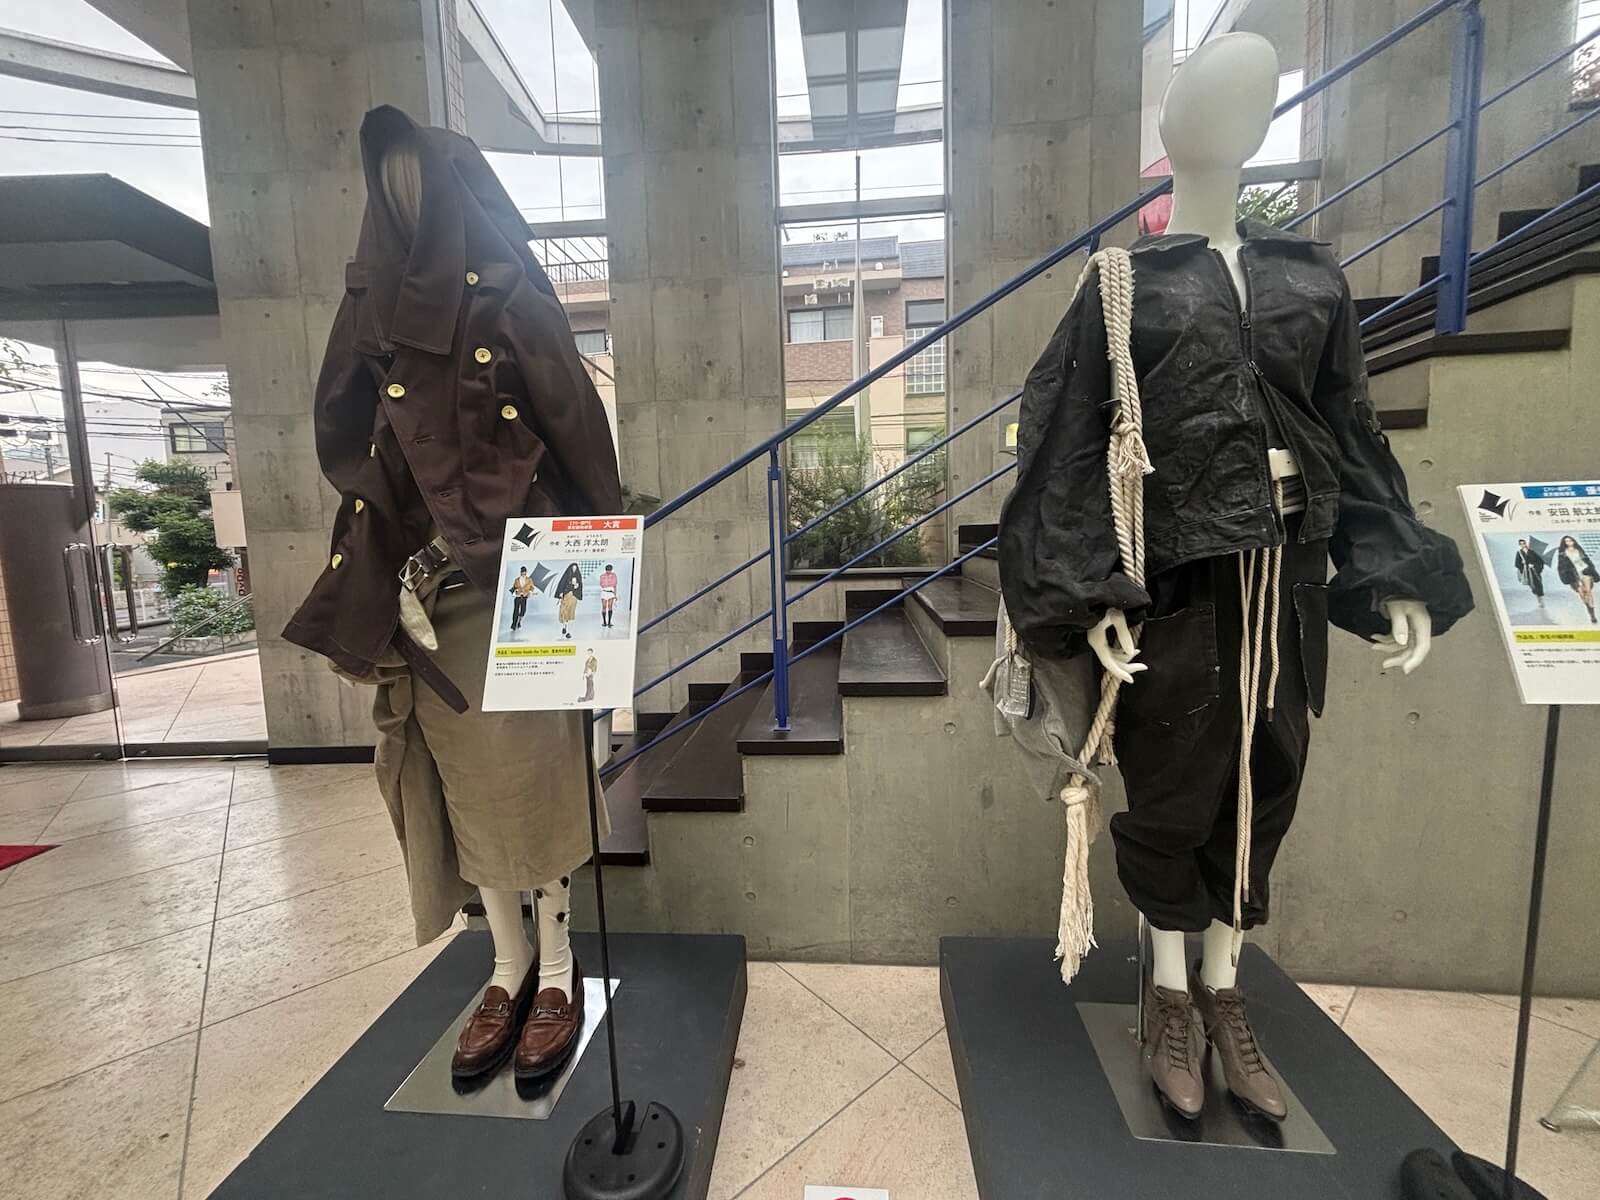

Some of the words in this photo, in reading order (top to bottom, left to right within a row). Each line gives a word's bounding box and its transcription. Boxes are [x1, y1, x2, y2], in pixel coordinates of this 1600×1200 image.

[1548, 507, 1570, 517] 安田
[603, 520, 621, 529] 大賞
[564, 538, 581, 547] 大西
